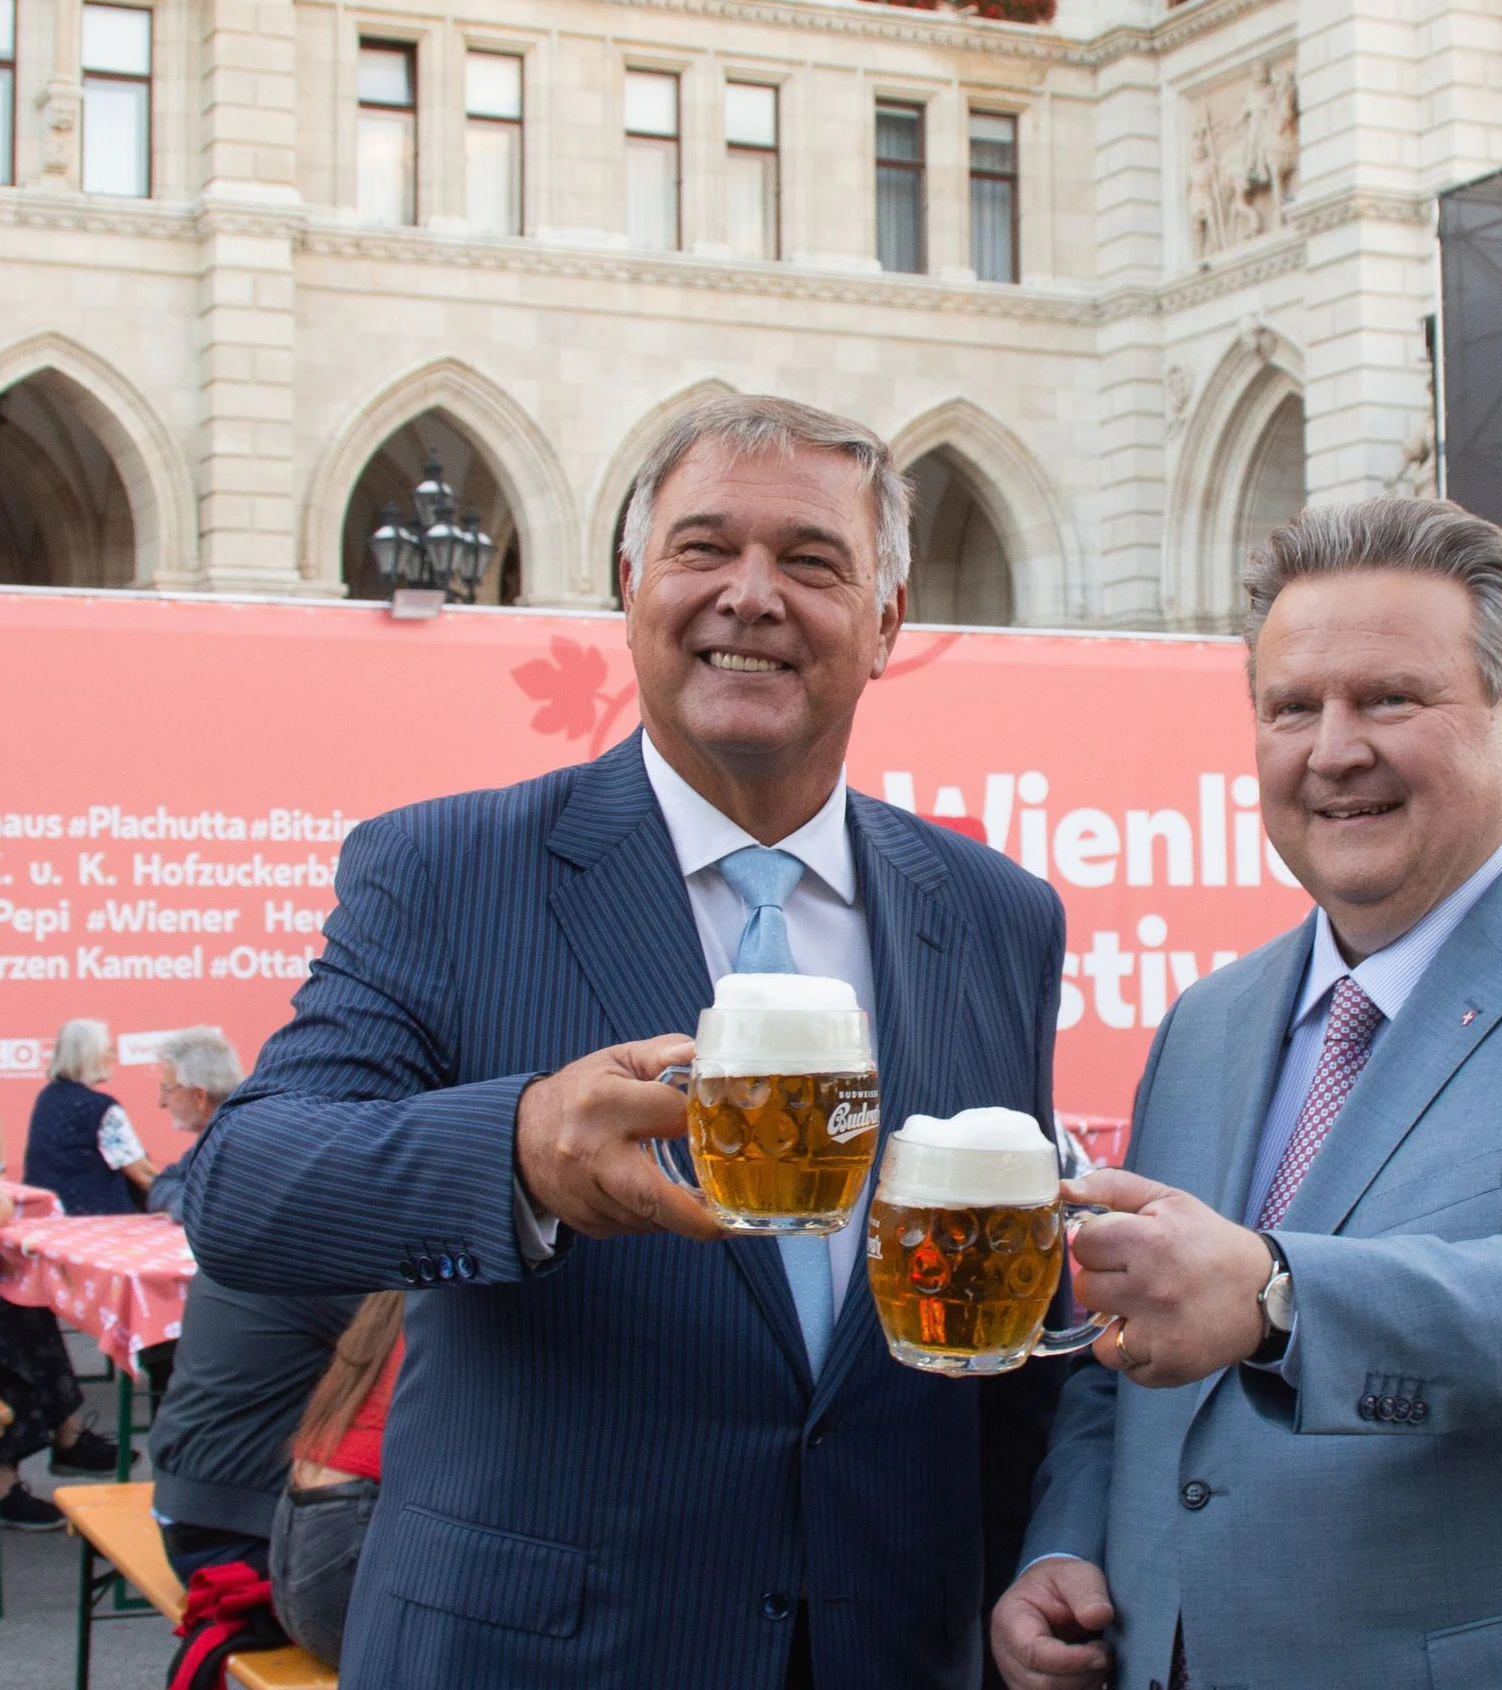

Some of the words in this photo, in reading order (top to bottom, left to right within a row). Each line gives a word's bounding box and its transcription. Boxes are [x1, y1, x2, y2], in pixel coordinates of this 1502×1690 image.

[0, 812, 64, 839] aus
[68, 803, 247, 841] #Plachutta
[883, 770, 1300, 889] Wienli
[78, 851, 118, 887] K.
[86, 898, 241, 934] #Wiener
[76, 944, 203, 980] Kameel
